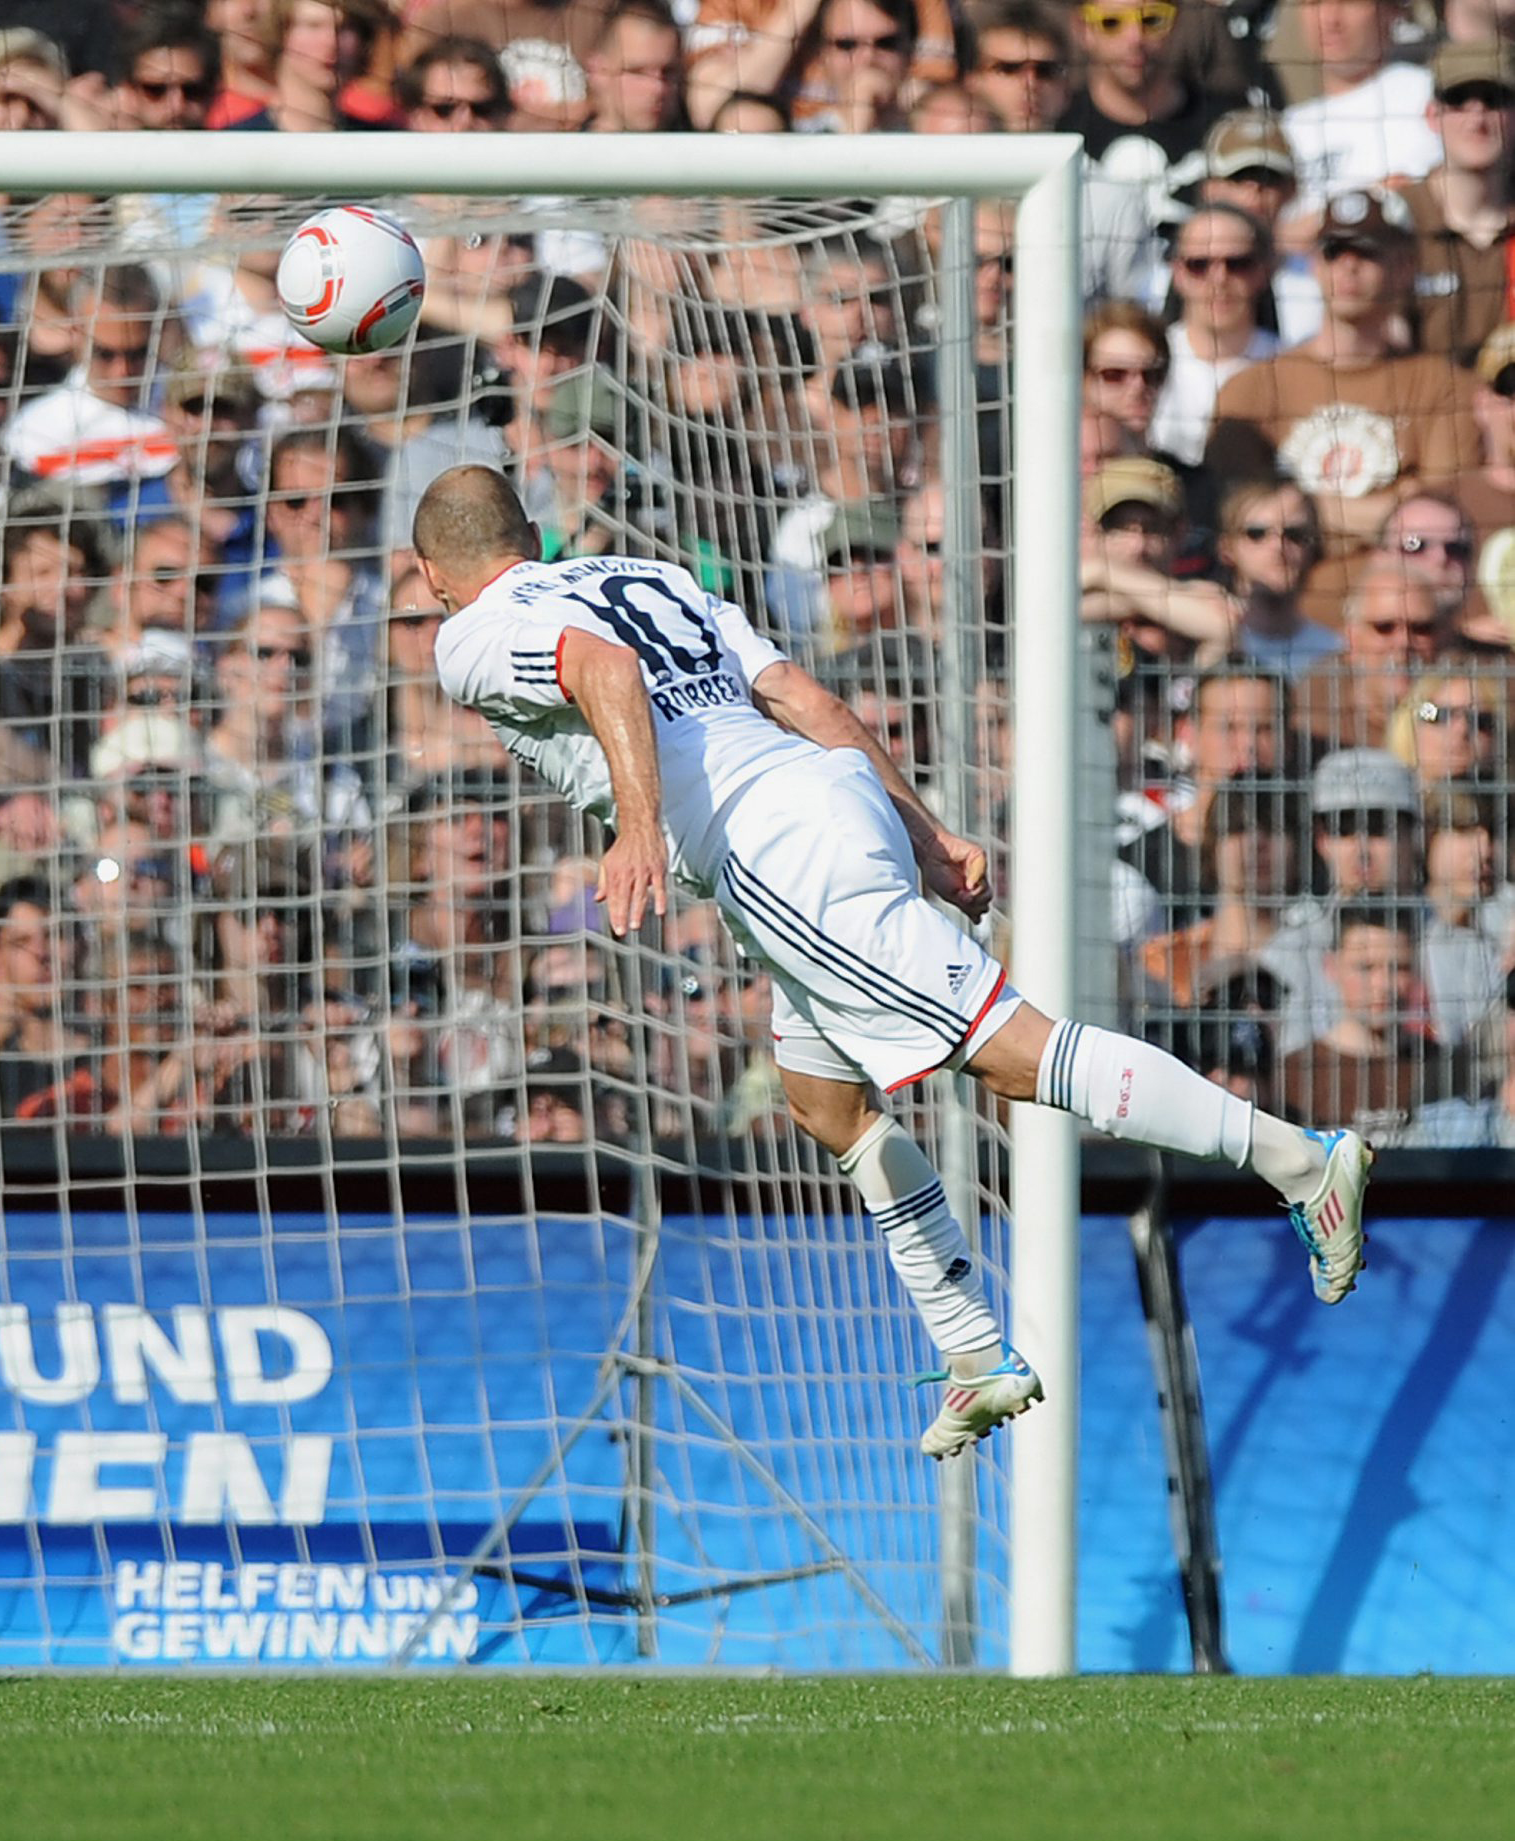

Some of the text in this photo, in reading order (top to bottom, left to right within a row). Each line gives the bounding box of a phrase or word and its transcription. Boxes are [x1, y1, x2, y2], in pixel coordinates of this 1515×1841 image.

[560, 575, 724, 686] 10
[114, 1560, 480, 1611] HELFEN UND
[112, 1611, 480, 1660] GEWINNEN
